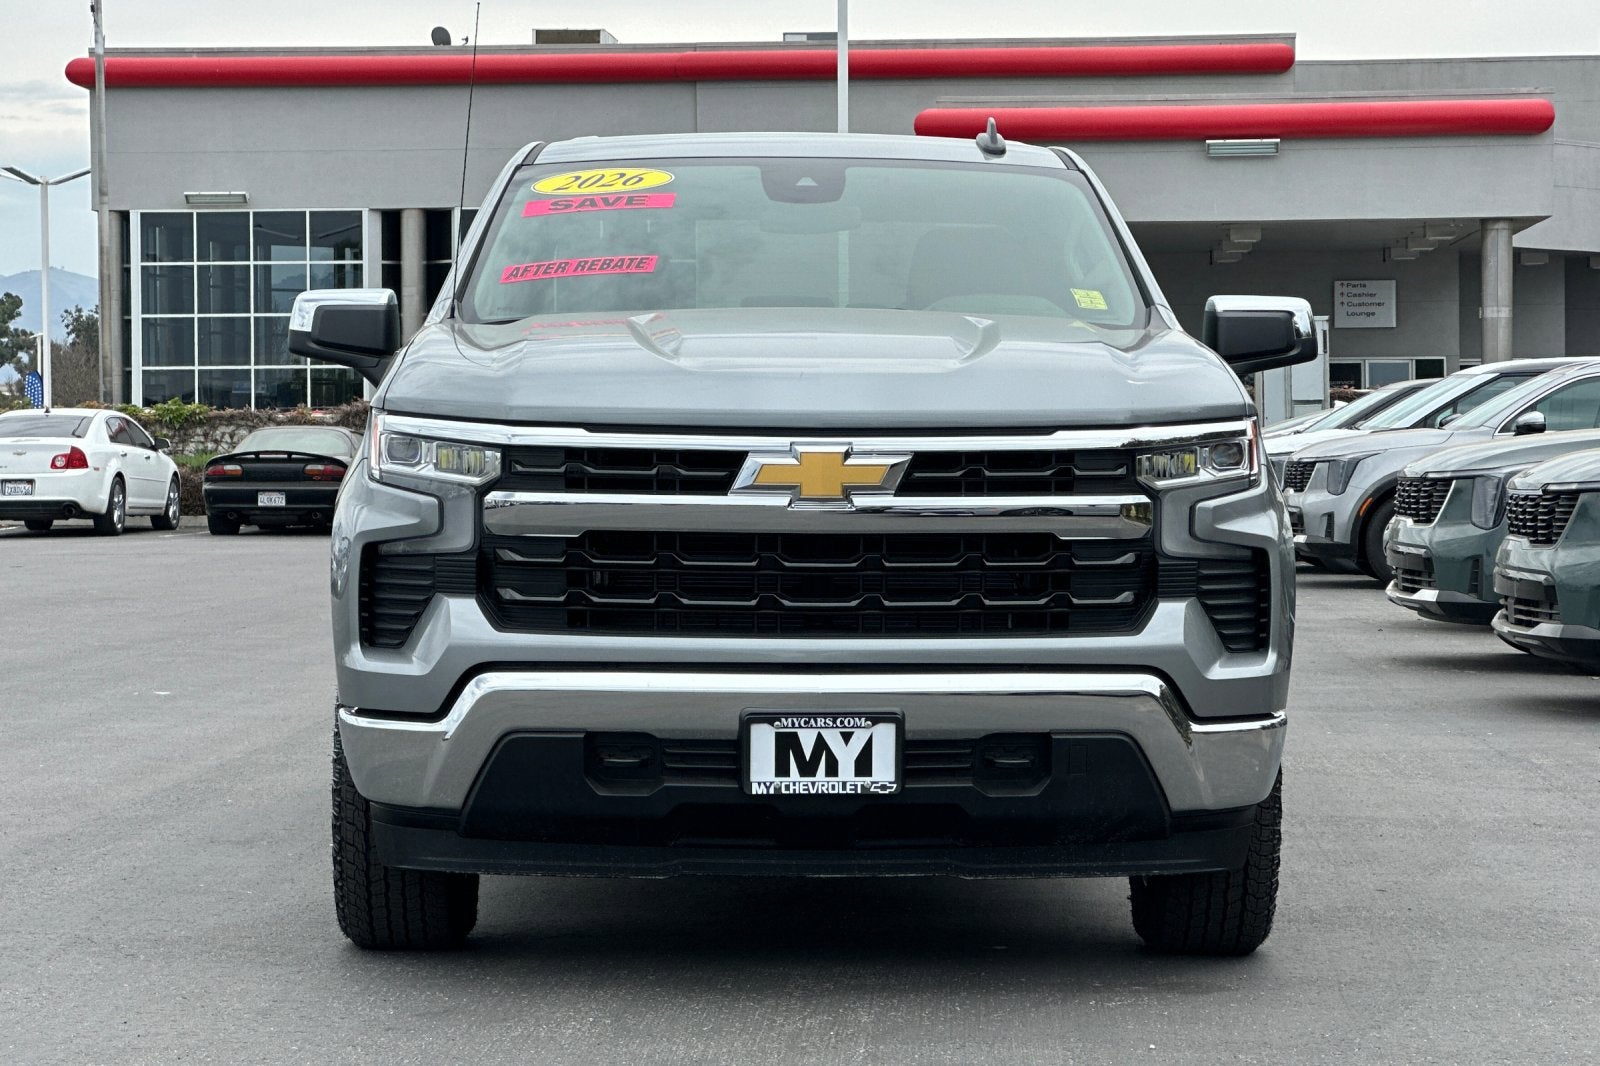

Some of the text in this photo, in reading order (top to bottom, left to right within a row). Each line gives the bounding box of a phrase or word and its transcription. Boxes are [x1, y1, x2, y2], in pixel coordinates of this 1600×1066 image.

[552, 171, 653, 191] 2026
[548, 195, 649, 211] SAVE
[506, 257, 651, 280] AFTER REBATE
[780, 717, 865, 728] MYCARS.COM
[751, 781, 863, 795] MY CHEVROLET
